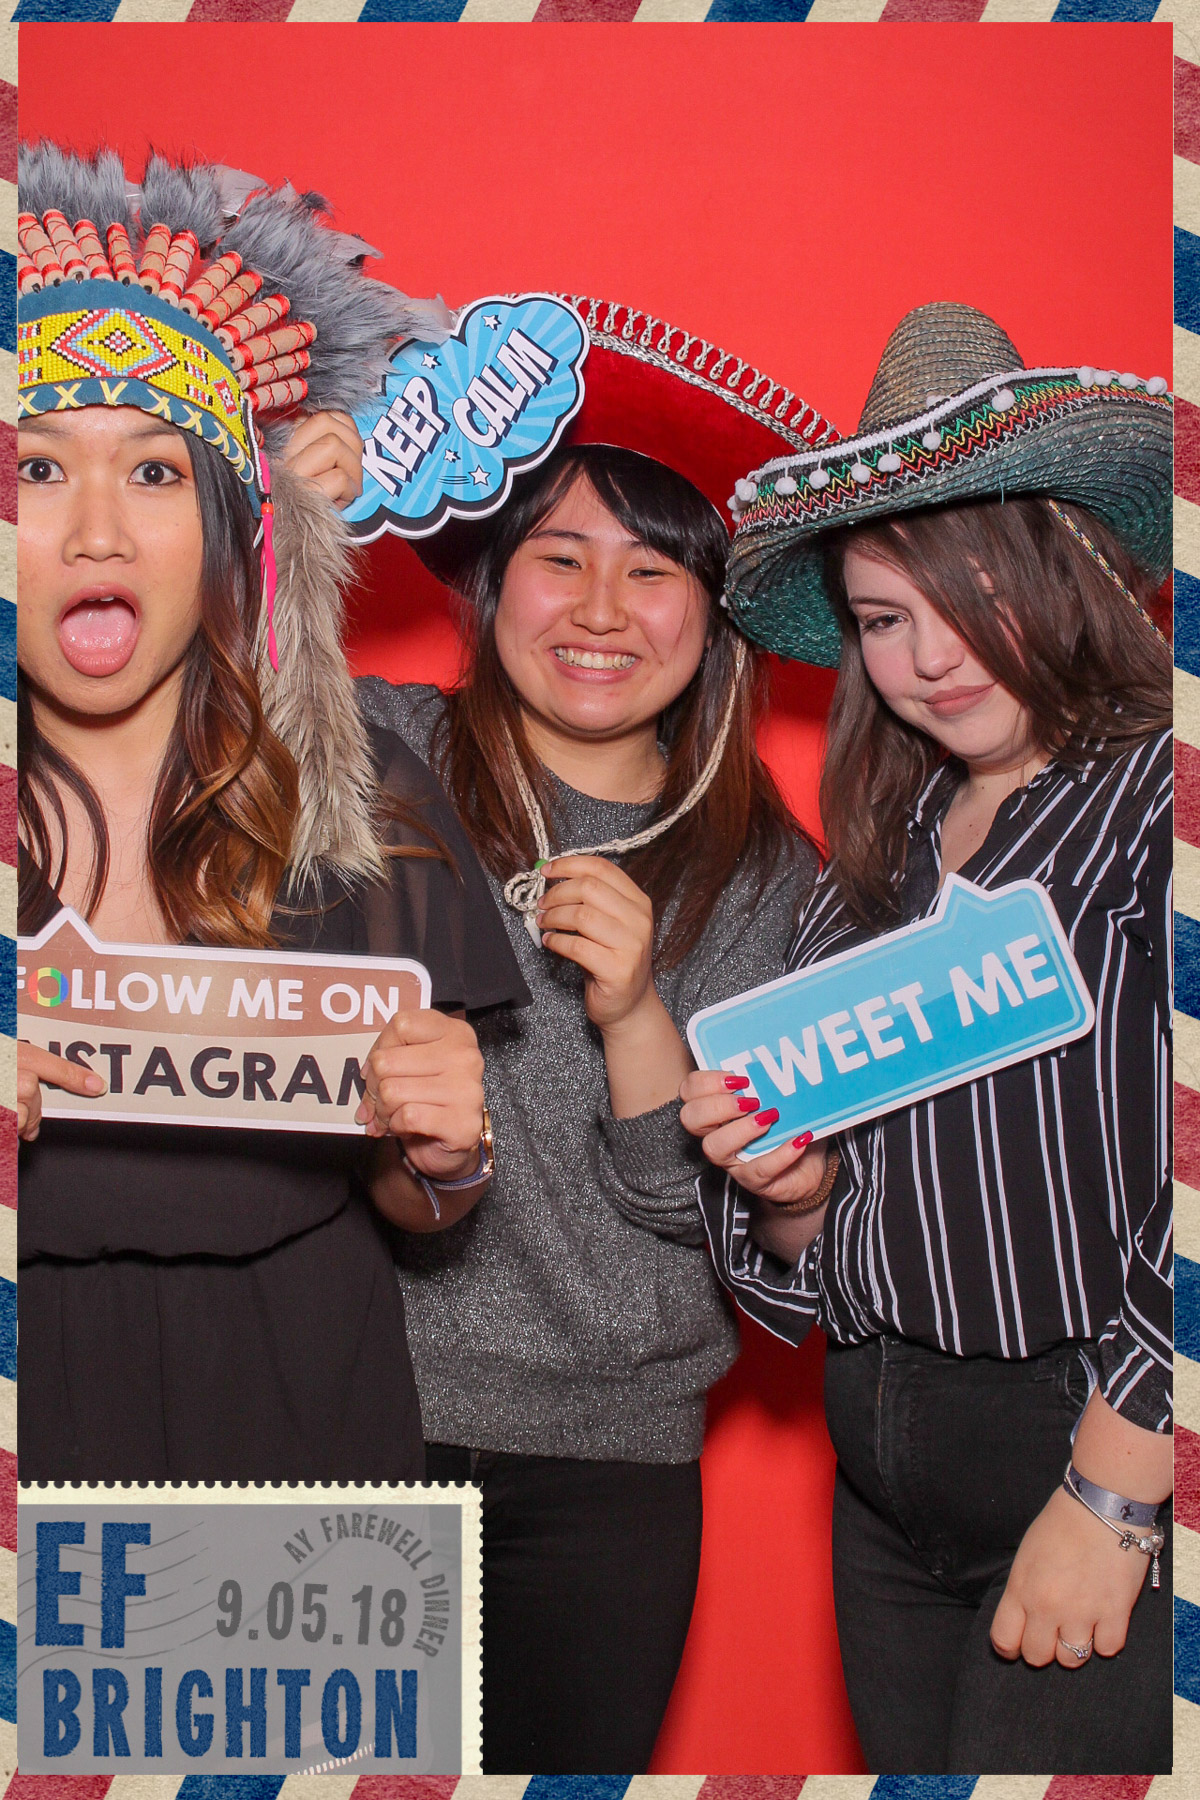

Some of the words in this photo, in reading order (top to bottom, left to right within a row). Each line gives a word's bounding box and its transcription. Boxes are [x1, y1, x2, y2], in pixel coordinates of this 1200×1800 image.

[362, 376, 449, 497] KEEP
[452, 328, 558, 448] CALM
[227, 978, 304, 1020] ME
[320, 983, 399, 1026] ON
[720, 982, 932, 1106] TWEET
[949, 934, 1059, 1027] ME
[17, 1039, 367, 1106] STAGRA
